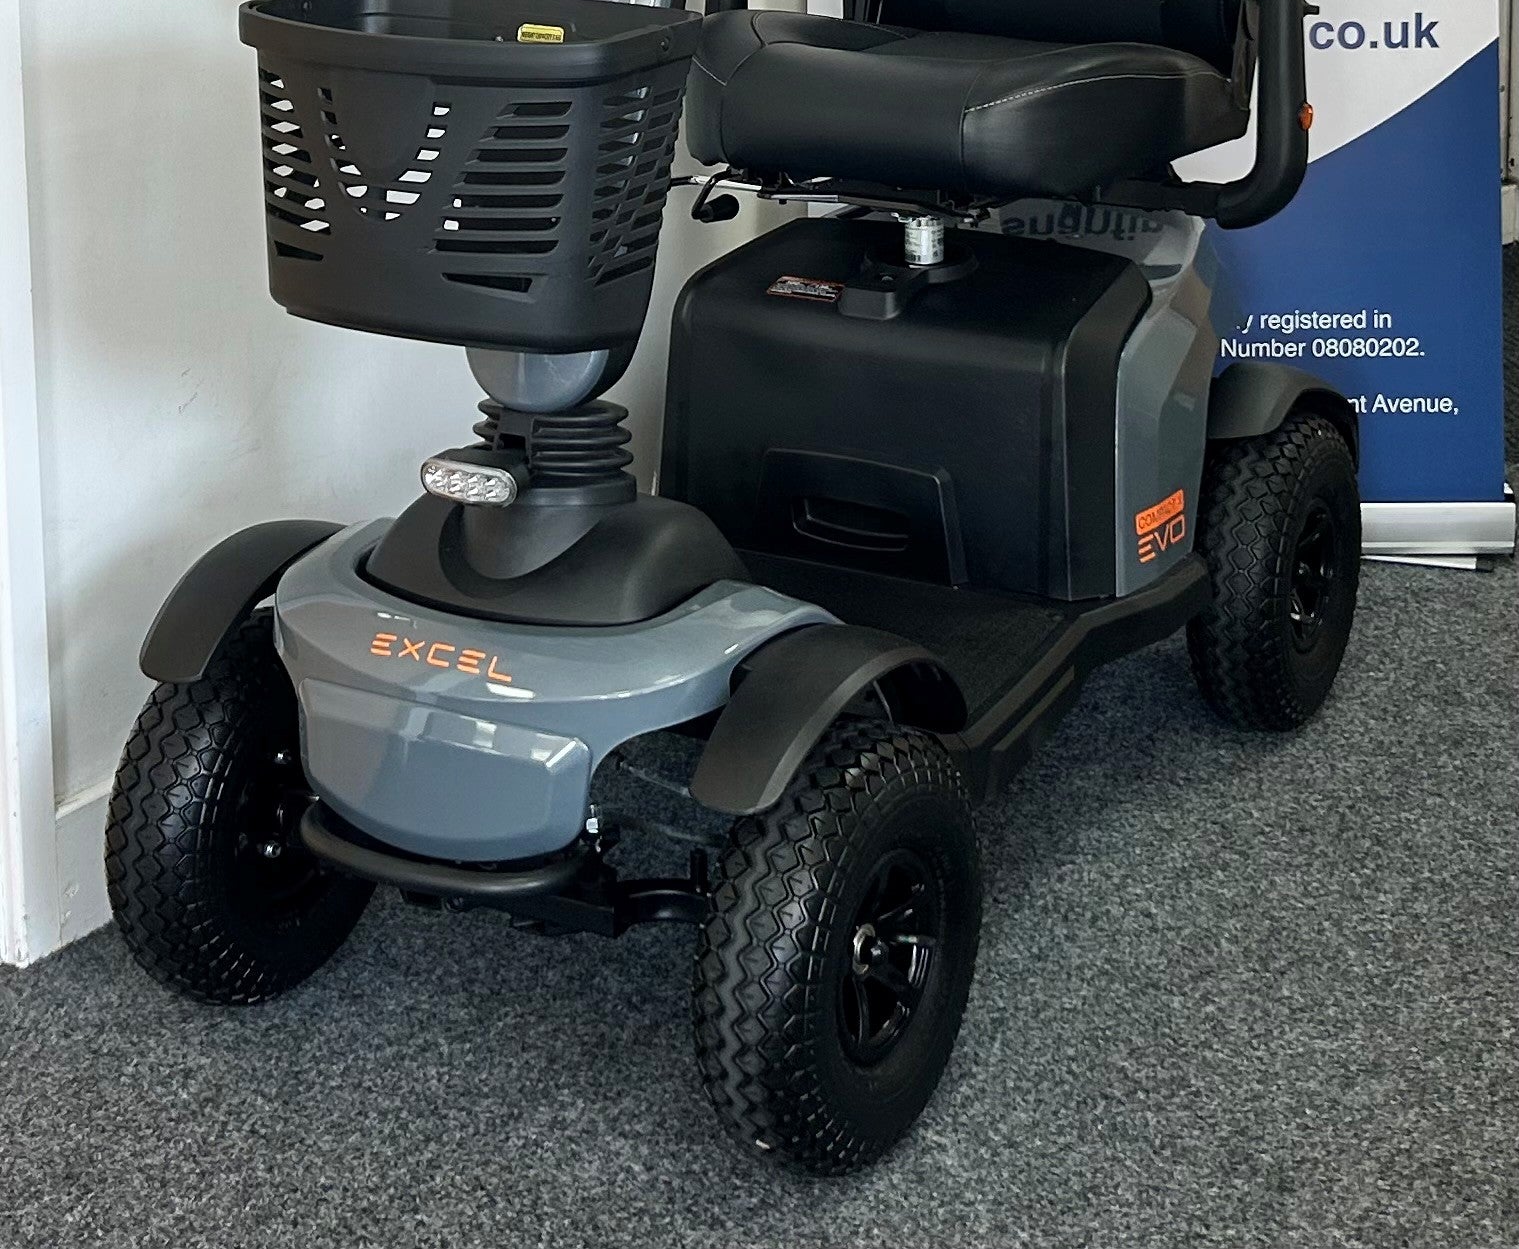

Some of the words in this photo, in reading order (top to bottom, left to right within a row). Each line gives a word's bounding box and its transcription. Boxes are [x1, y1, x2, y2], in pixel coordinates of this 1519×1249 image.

[1260, 310, 1366, 334] registered
[1373, 310, 1392, 329] in
[1221, 339, 1306, 358] Number
[1312, 338, 1426, 358] 08080202.
[1372, 394, 1459, 415] Avenue,
[1138, 514, 1185, 563] EVO
[370, 632, 512, 683] EXCEL
